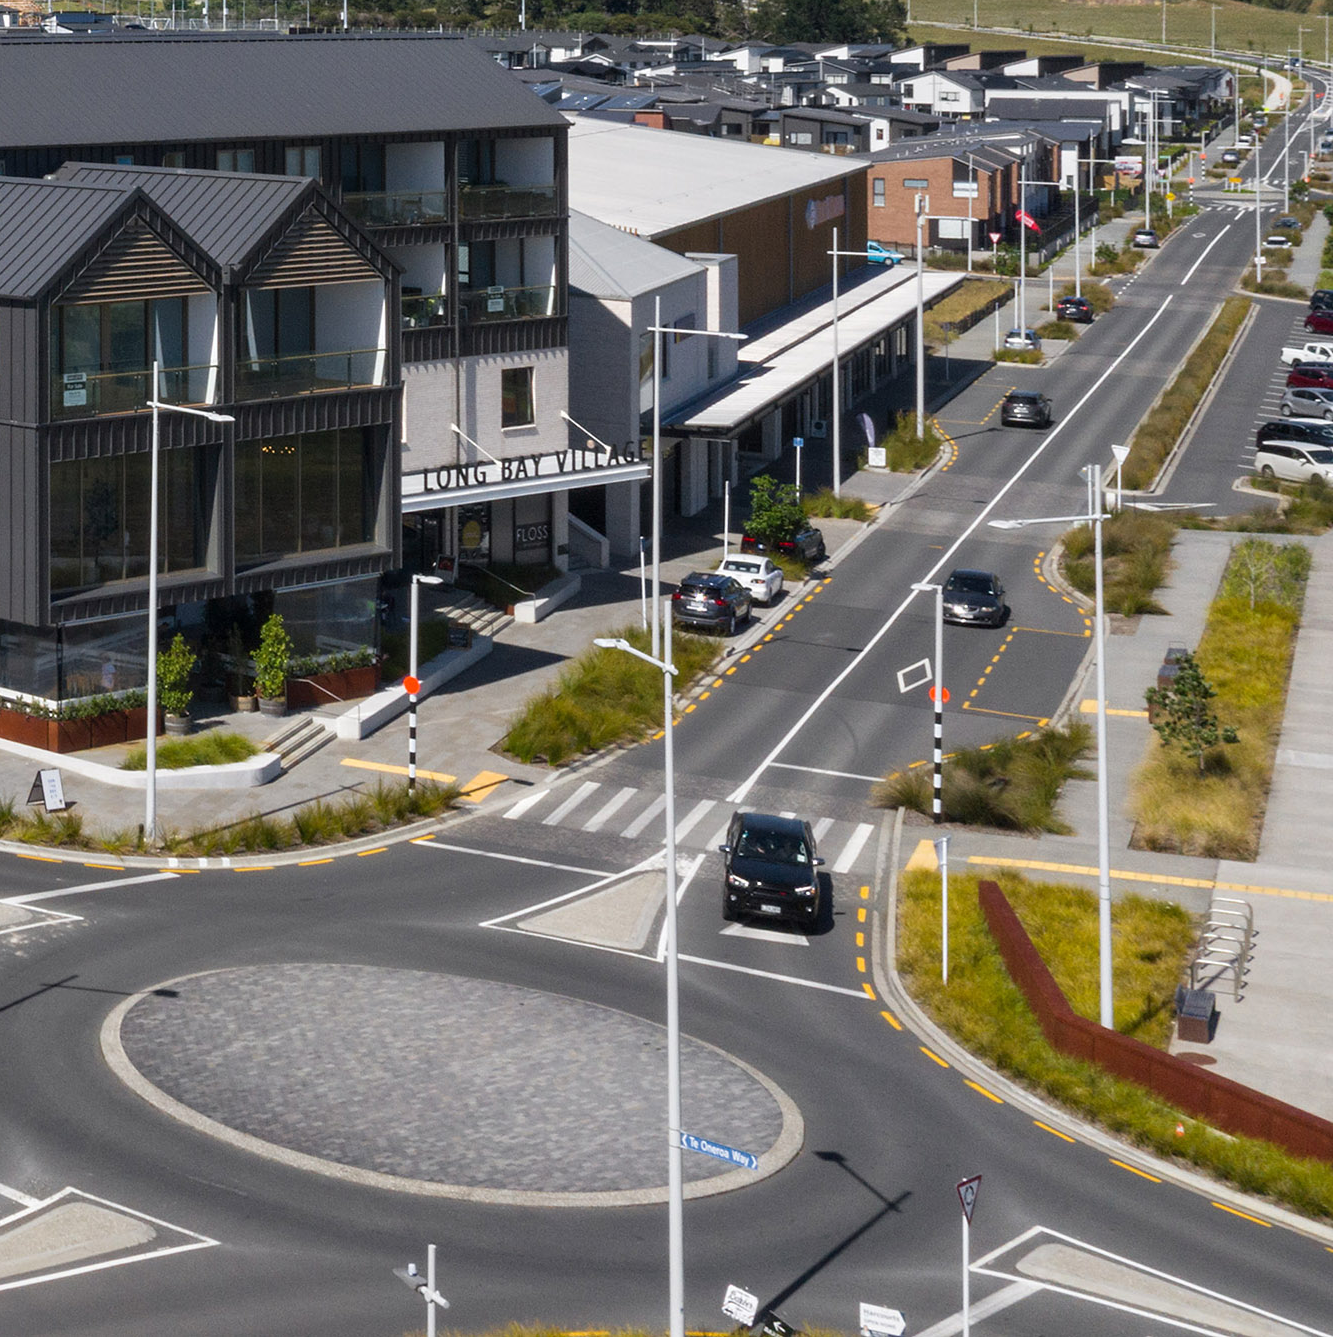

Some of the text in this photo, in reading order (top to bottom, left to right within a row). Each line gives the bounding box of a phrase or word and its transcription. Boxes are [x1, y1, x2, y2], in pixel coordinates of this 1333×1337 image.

[424, 439, 648, 492] LONG BAY VILLAGE
[516, 524, 549, 542] FLOSS
[688, 1136, 749, 1167] Te Oneroa Way
